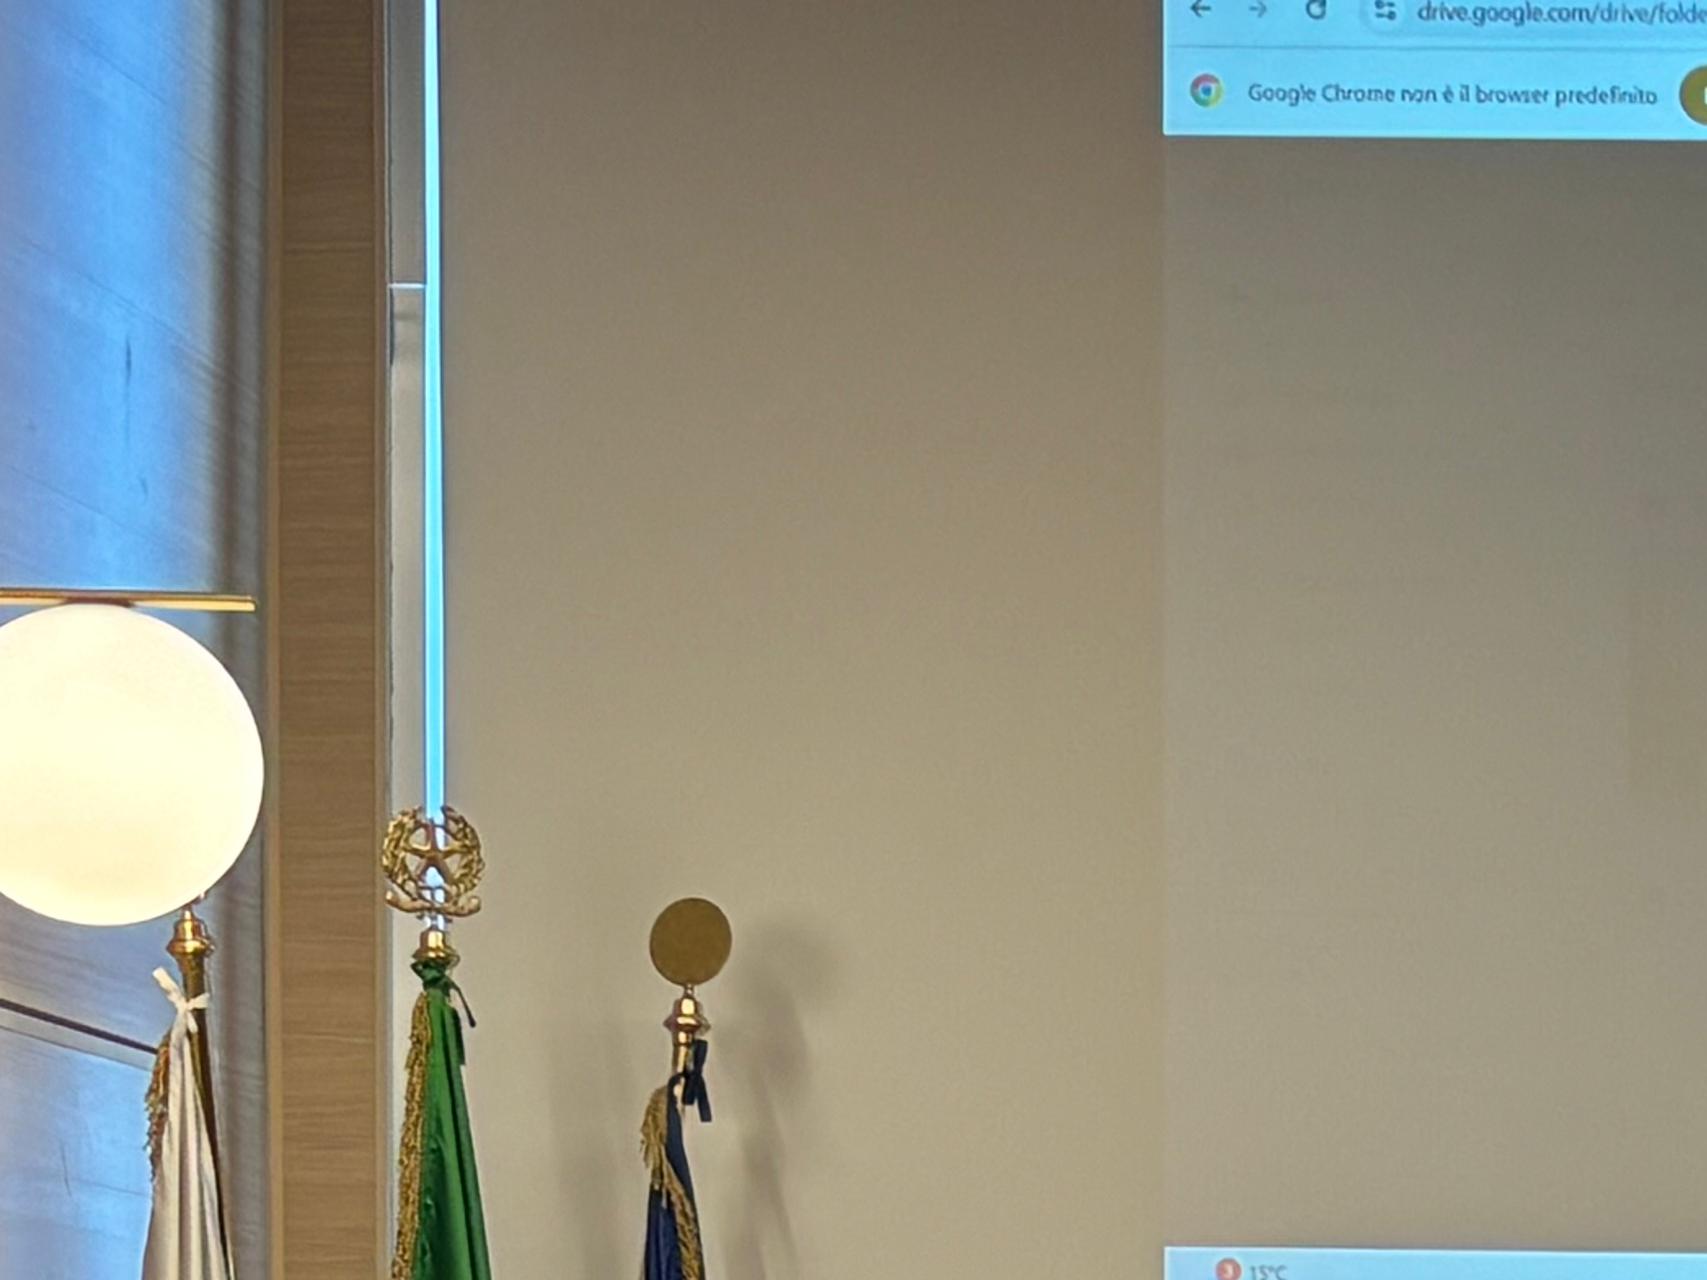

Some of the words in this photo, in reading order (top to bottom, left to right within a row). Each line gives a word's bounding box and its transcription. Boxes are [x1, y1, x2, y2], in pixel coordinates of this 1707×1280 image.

[1248, 83, 1316, 107] Google
[1321, 84, 1396, 104] Chrome
[1400, 88, 1438, 104] non
[1443, 84, 1454, 104] è
[1459, 84, 1470, 103] il
[1475, 85, 1549, 104] browser
[1555, 85, 1658, 110] predefinito
